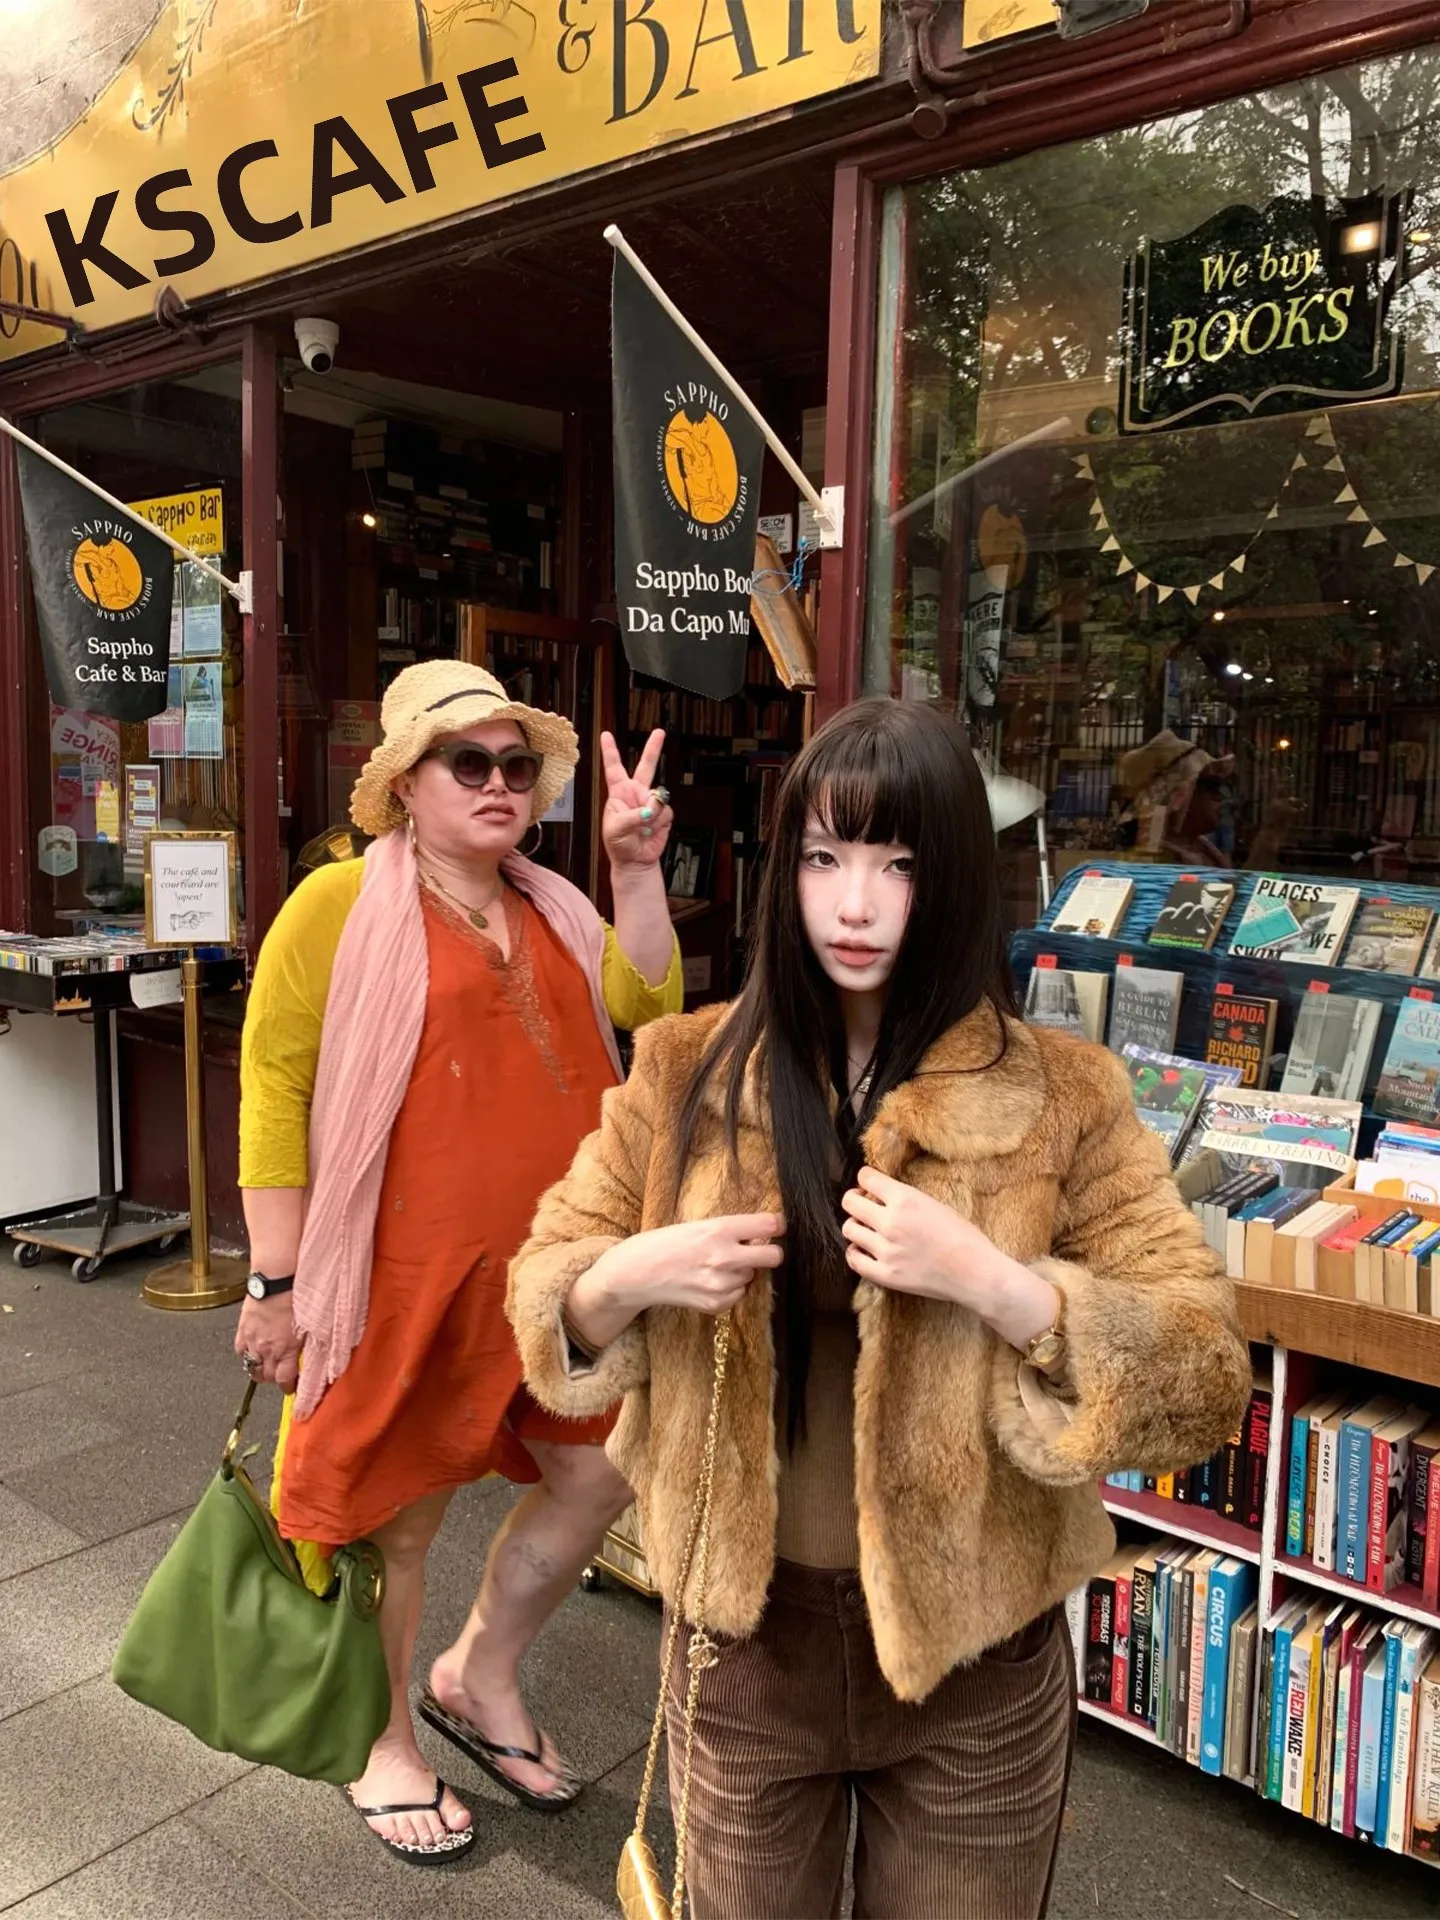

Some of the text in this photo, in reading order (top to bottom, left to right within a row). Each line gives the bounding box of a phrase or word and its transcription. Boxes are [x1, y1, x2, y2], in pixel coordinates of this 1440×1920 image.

[45, 57, 546, 308] KSCAFE
[1200, 244, 1321, 294] We buy
[1161, 285, 1355, 370] BOOKS
[664, 381, 729, 421] SAPPHO
[200, 494, 220, 521] Bar
[686, 475, 748, 542] BOOKS CAFE BAR
[71, 519, 133, 544] SAPPHO
[635, 562, 720, 598] Sappho
[626, 606, 666, 633] Da
[671, 607, 724, 641] Capo
[87, 636, 153, 660] Sappho
[75, 663, 167, 683] Cafe & Bar
[160, 879, 220, 889] courtyard are
[162, 867, 179, 876] The
[201, 867, 218, 876] and
[1256, 879, 1323, 903] PLACES
[1309, 933, 1337, 950] WE
[1117, 1001, 1169, 1022] BERLIN
[1159, 999, 1171, 1008] TO
[1212, 1002, 1266, 1025] CANADA
[1207, 1039, 1261, 1061] RICHARD
[1251, 1401, 1270, 1456] PLAGUE
[1228, 1449, 1236, 1475] MICHAEL
[1322, 1444, 1330, 1484] CHOICE
[1415, 1454, 1429, 1510] DIVERGENT
[1431, 1469, 1440, 1509] TWELVE
[1289, 1509, 1301, 1541] DEAD
[1411, 1540, 1419, 1565] ROTH
[1133, 1572, 1147, 1617] RYAN
[1144, 1578, 1152, 1616] ANTHONY
[1209, 1586, 1226, 1648] CIRCUS
[1135, 1634, 1145, 1700] THE WOLF'S CALL
[1394, 1707, 1409, 1785] Soft Furnishings
[1420, 1748, 1430, 1798] TOURNAMENT
[1427, 1714, 1440, 1823] MATTHEW REILLY
